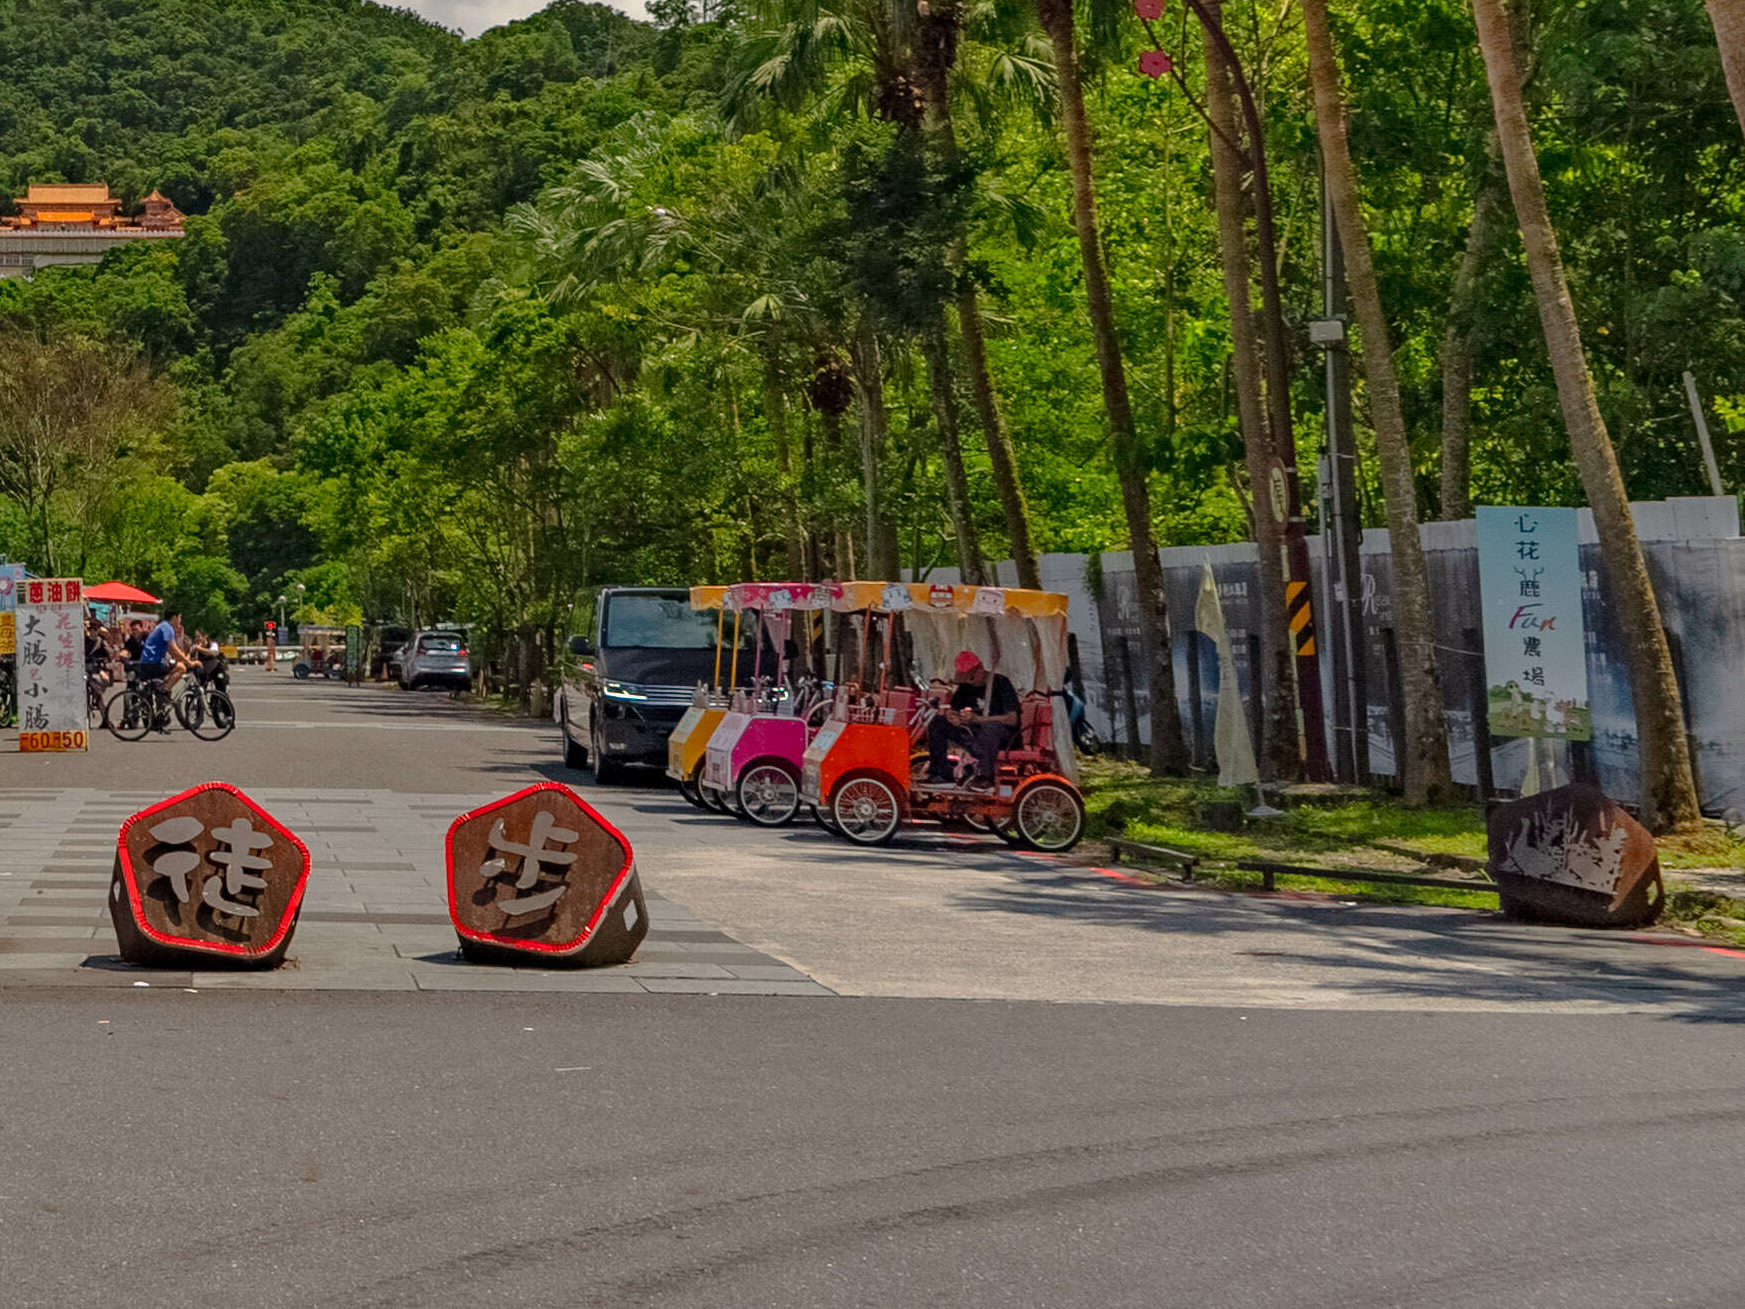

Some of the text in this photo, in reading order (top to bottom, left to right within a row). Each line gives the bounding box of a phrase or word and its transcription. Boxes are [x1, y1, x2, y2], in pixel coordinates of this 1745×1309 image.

[30, 732, 51, 749] 60
[62, 731, 84, 748] 50
[149, 816, 274, 918] 徒
[479, 811, 580, 916] 步
